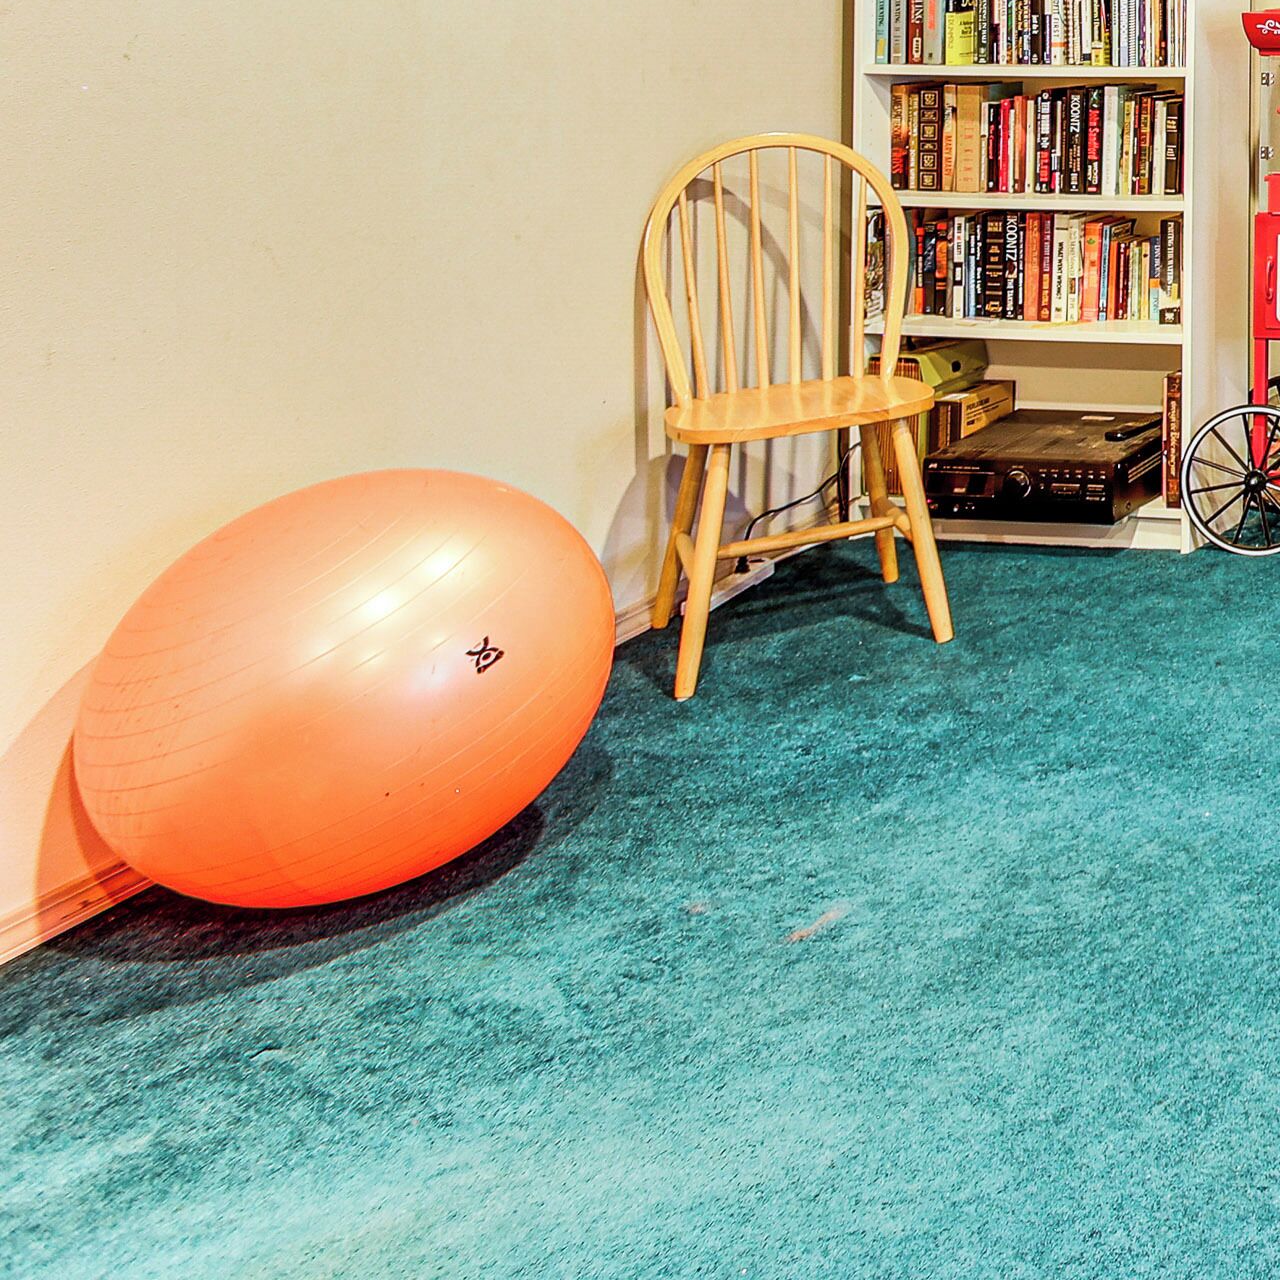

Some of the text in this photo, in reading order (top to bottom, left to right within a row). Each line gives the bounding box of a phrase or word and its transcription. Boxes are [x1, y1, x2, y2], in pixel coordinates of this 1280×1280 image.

[1070, 96, 1080, 133] KOONTZ
[1089, 109, 1100, 160] John Sandford
[892, 147, 906, 174] CROSS
[944, 135, 952, 177] MARY MARY
[1005, 218, 1017, 261] KOONTZ
[1167, 221, 1175, 284] PARTING THE WATERS
